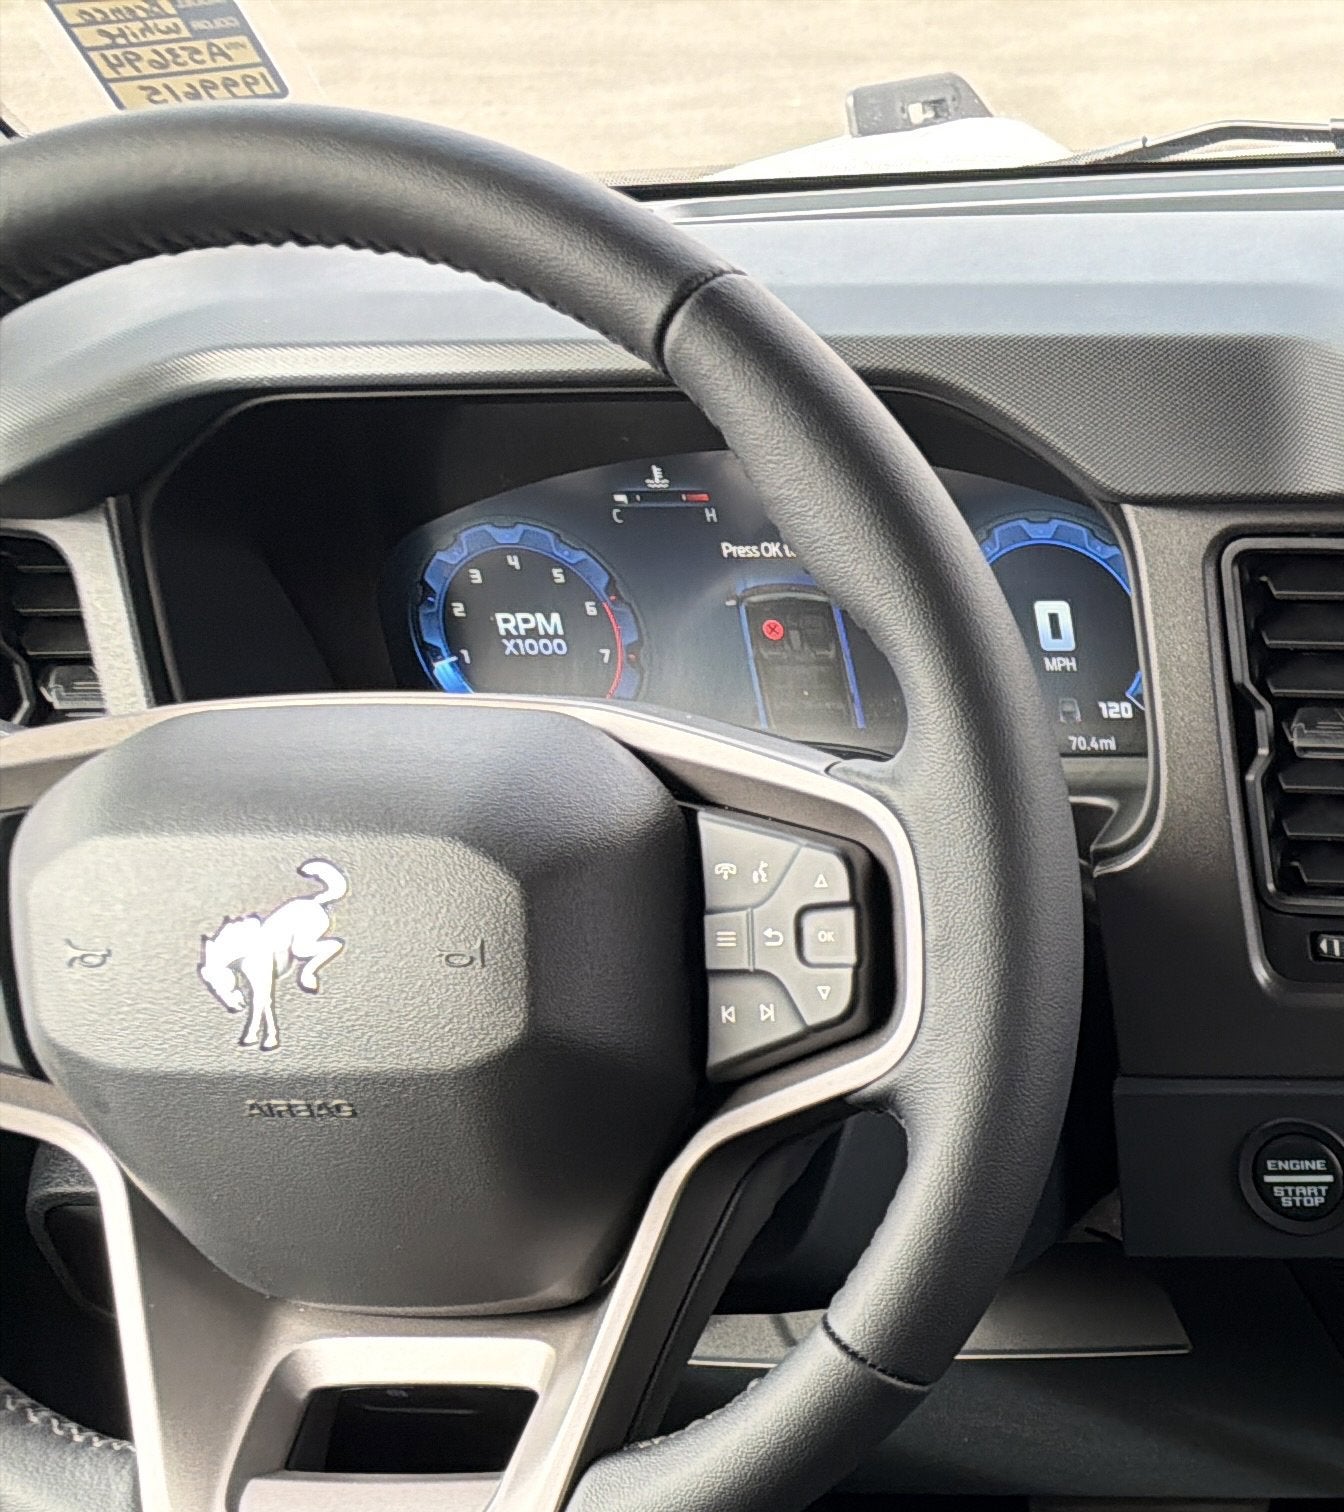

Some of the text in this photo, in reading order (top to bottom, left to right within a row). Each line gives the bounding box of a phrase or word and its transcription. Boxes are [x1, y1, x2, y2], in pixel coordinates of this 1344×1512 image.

[613, 509, 623, 523] C
[705, 507, 718, 523] H
[721, 542, 759, 559] Press
[761, 542, 782, 558] OK
[507, 555, 520, 570] 4
[468, 569, 482, 584] 3
[552, 569, 565, 583] 5
[451, 602, 466, 617] 2
[585, 601, 597, 616] 6
[495, 613, 564, 635] RPM
[1034, 601, 1075, 651] 0
[501, 639, 568, 655] X1000
[460, 649, 471, 664] 1
[599, 649, 610, 663] 7
[1043, 657, 1077, 672] MPH
[1098, 701, 1133, 718] 120
[818, 931, 835, 943] OK
[243, 1099, 358, 1118] AIRBAG
[1267, 1160, 1327, 1170] ENGINE
[1273, 1186, 1328, 1197] START
[1281, 1197, 1325, 1207] STOP
